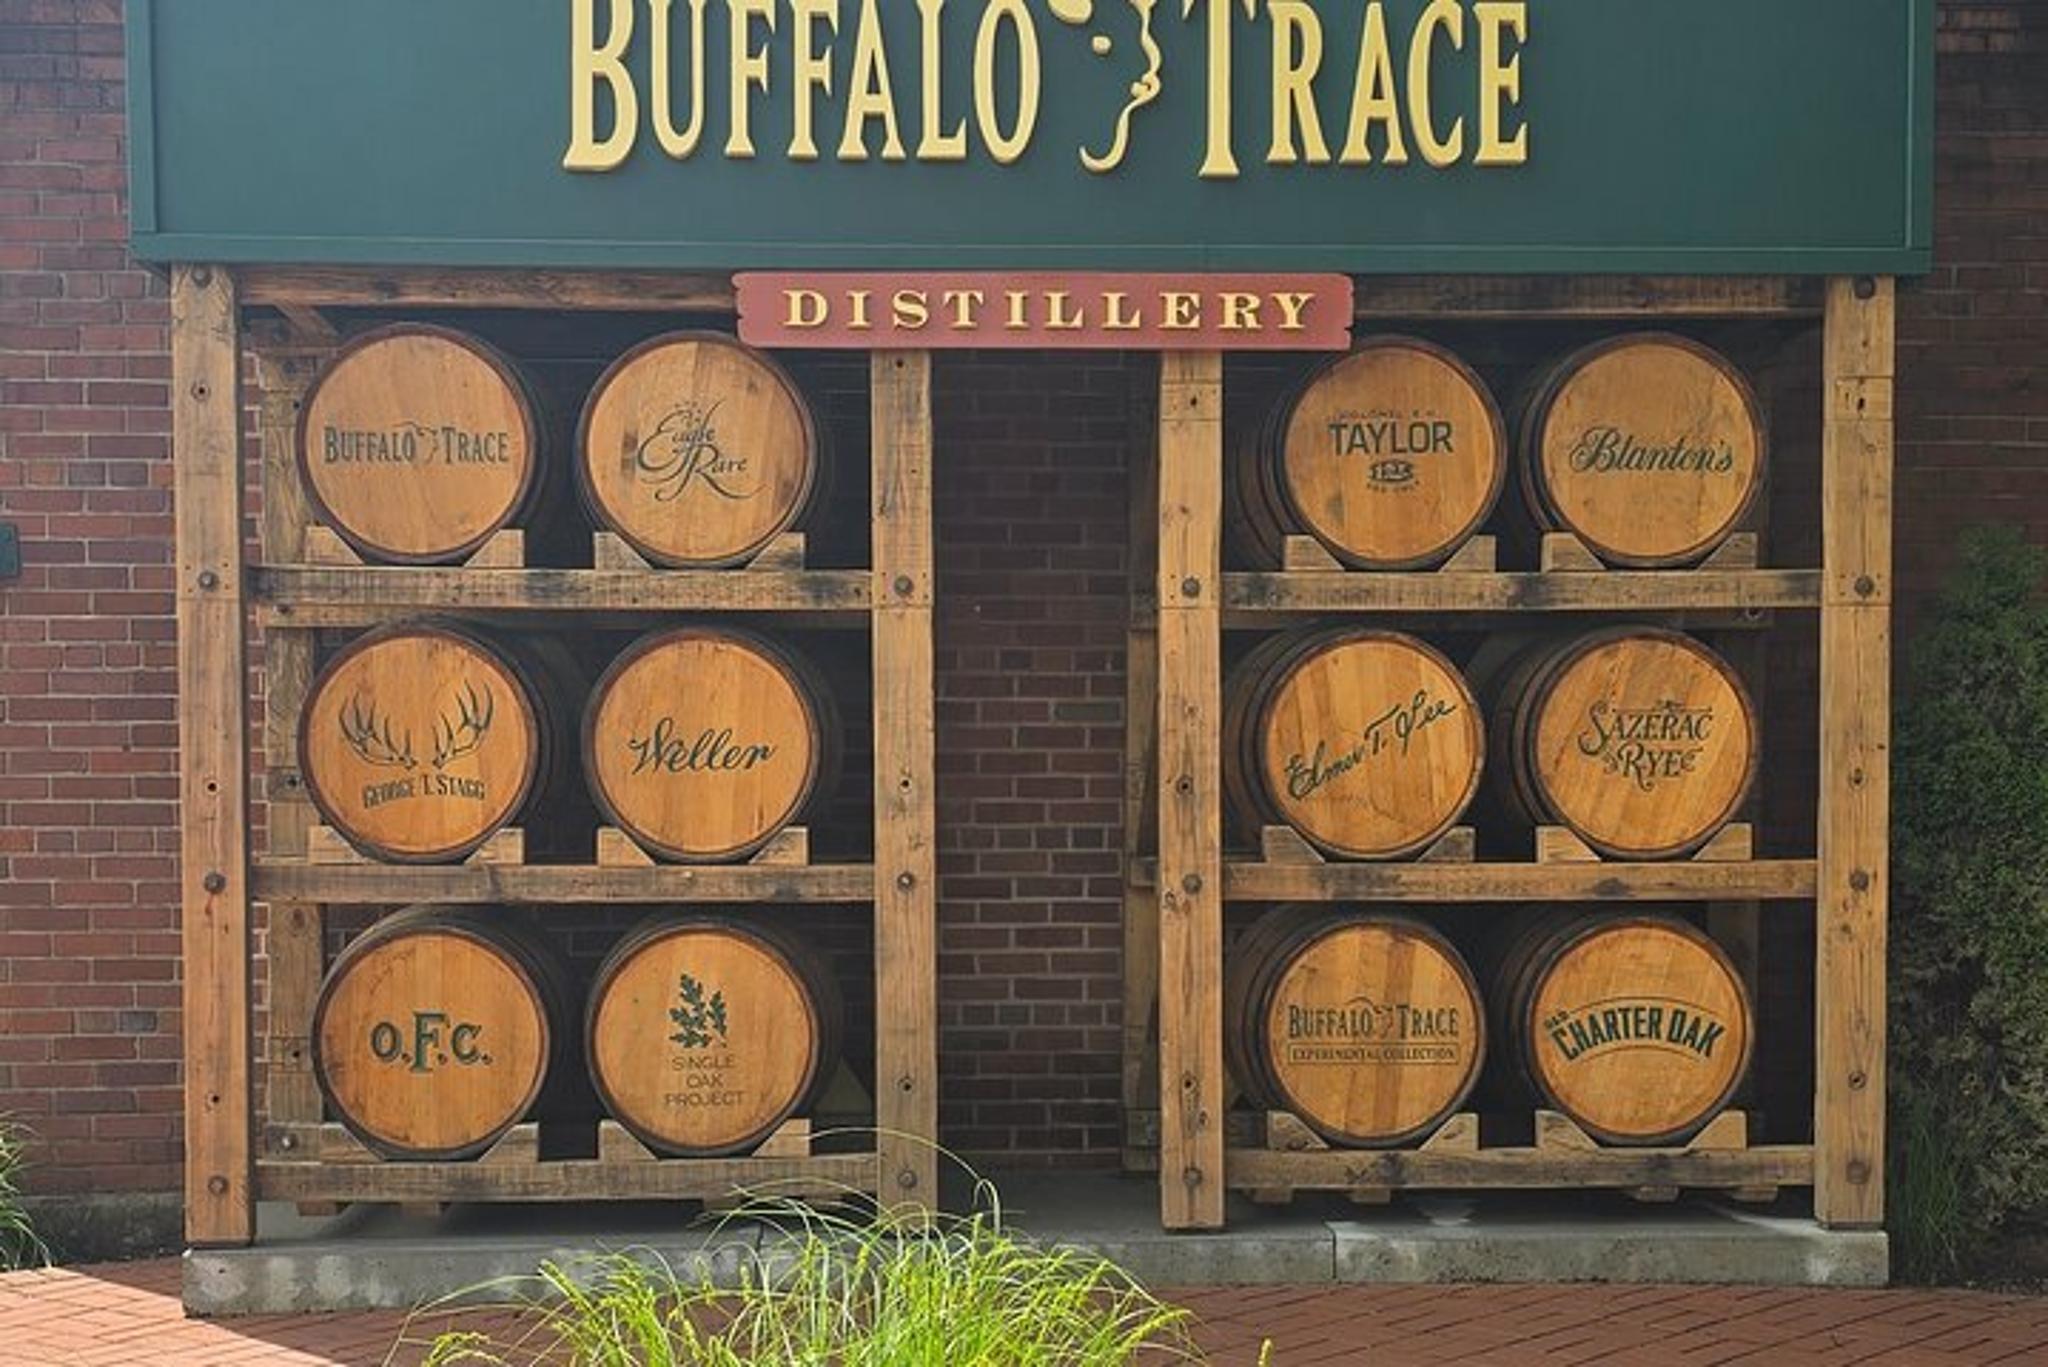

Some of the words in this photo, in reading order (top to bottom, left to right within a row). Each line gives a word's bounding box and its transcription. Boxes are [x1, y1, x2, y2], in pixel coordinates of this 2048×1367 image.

[563, 0, 1040, 172] BUFFALO
[1182, 0, 1528, 177] TRACE
[783, 289, 1316, 330] DISTILLERY
[323, 426, 417, 465] BUFFALO
[440, 426, 510, 465] TRACE
[1328, 420, 1454, 456] TAYLOR
[1568, 426, 1734, 474] Blanton's
[654, 443, 772, 502] Rare
[629, 716, 778, 776] Weller
[1577, 700, 1714, 757] SAZERAC
[1615, 742, 1688, 793] RYE
[1287, 1004, 1375, 1040] BUFFALO
[1394, 1004, 1460, 1040] TRACE
[1551, 1006, 1663, 1061] CHARTER
[1666, 1008, 1726, 1058] OAK
[671, 1053, 737, 1072] SINGLE
[685, 1072, 724, 1089] OAK
[664, 1089, 746, 1107] PROJECT
